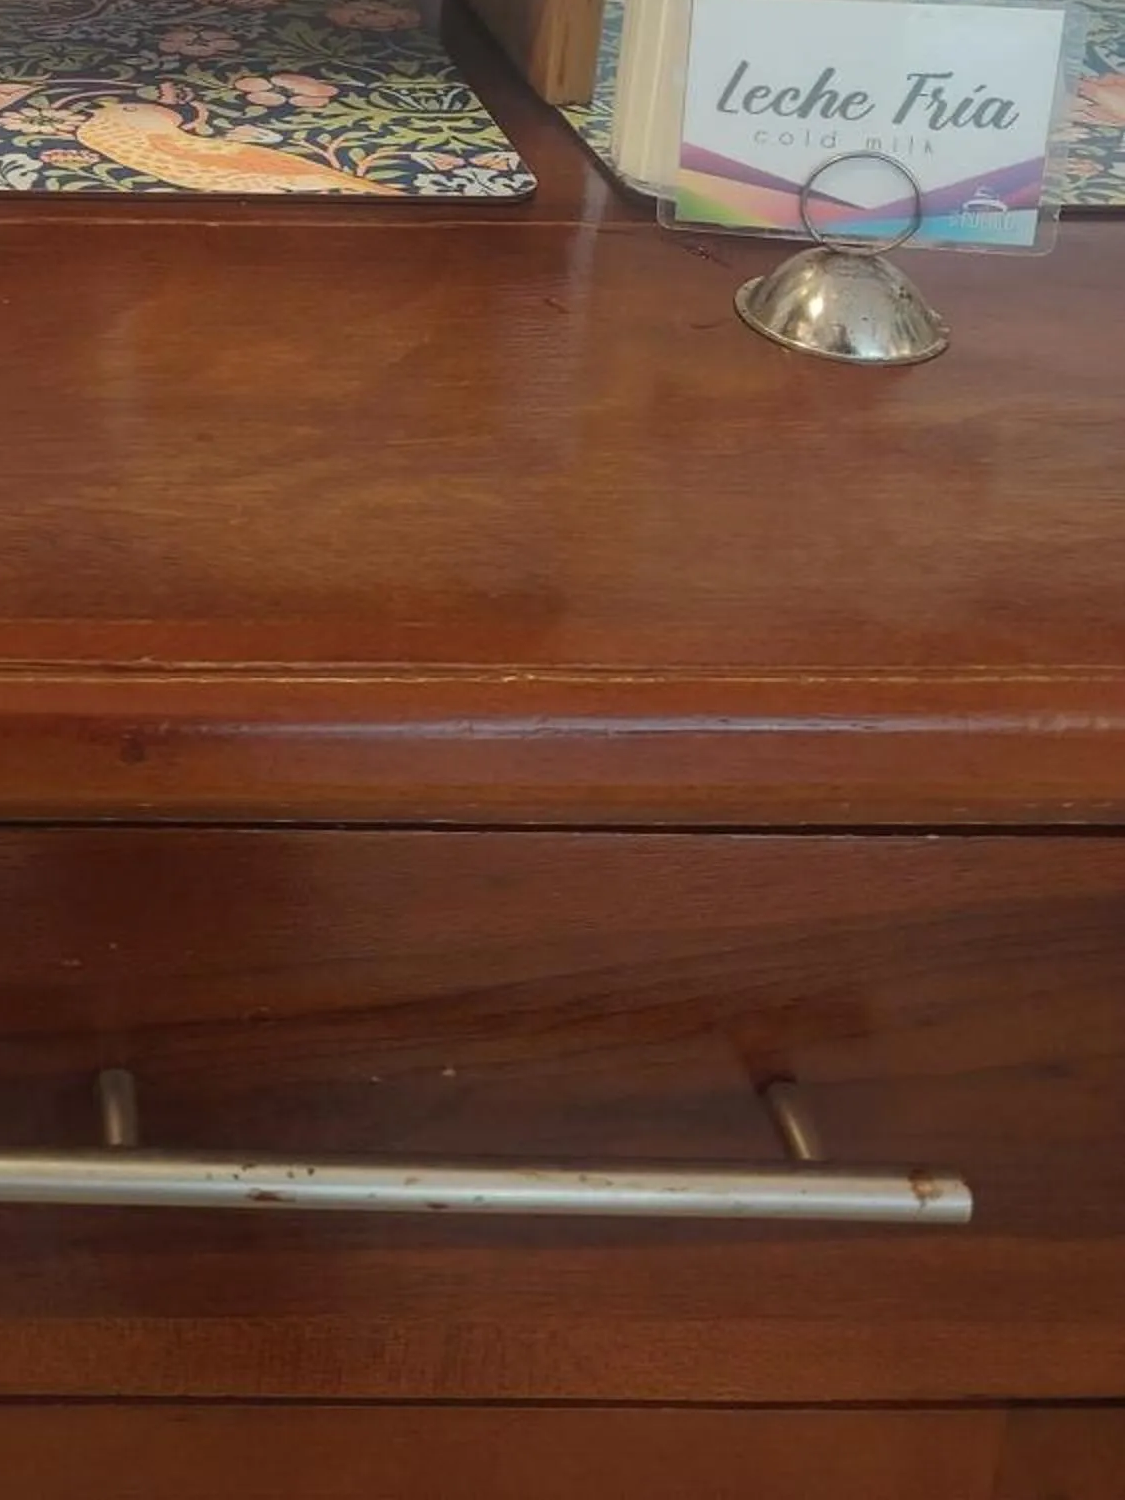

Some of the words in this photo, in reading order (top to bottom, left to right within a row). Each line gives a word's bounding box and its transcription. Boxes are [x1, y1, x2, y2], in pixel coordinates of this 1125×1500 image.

[715, 59, 876, 121] Leche
[891, 70, 1021, 132] Fría
[753, 129, 839, 150] cold
[864, 133, 935, 155] milk
